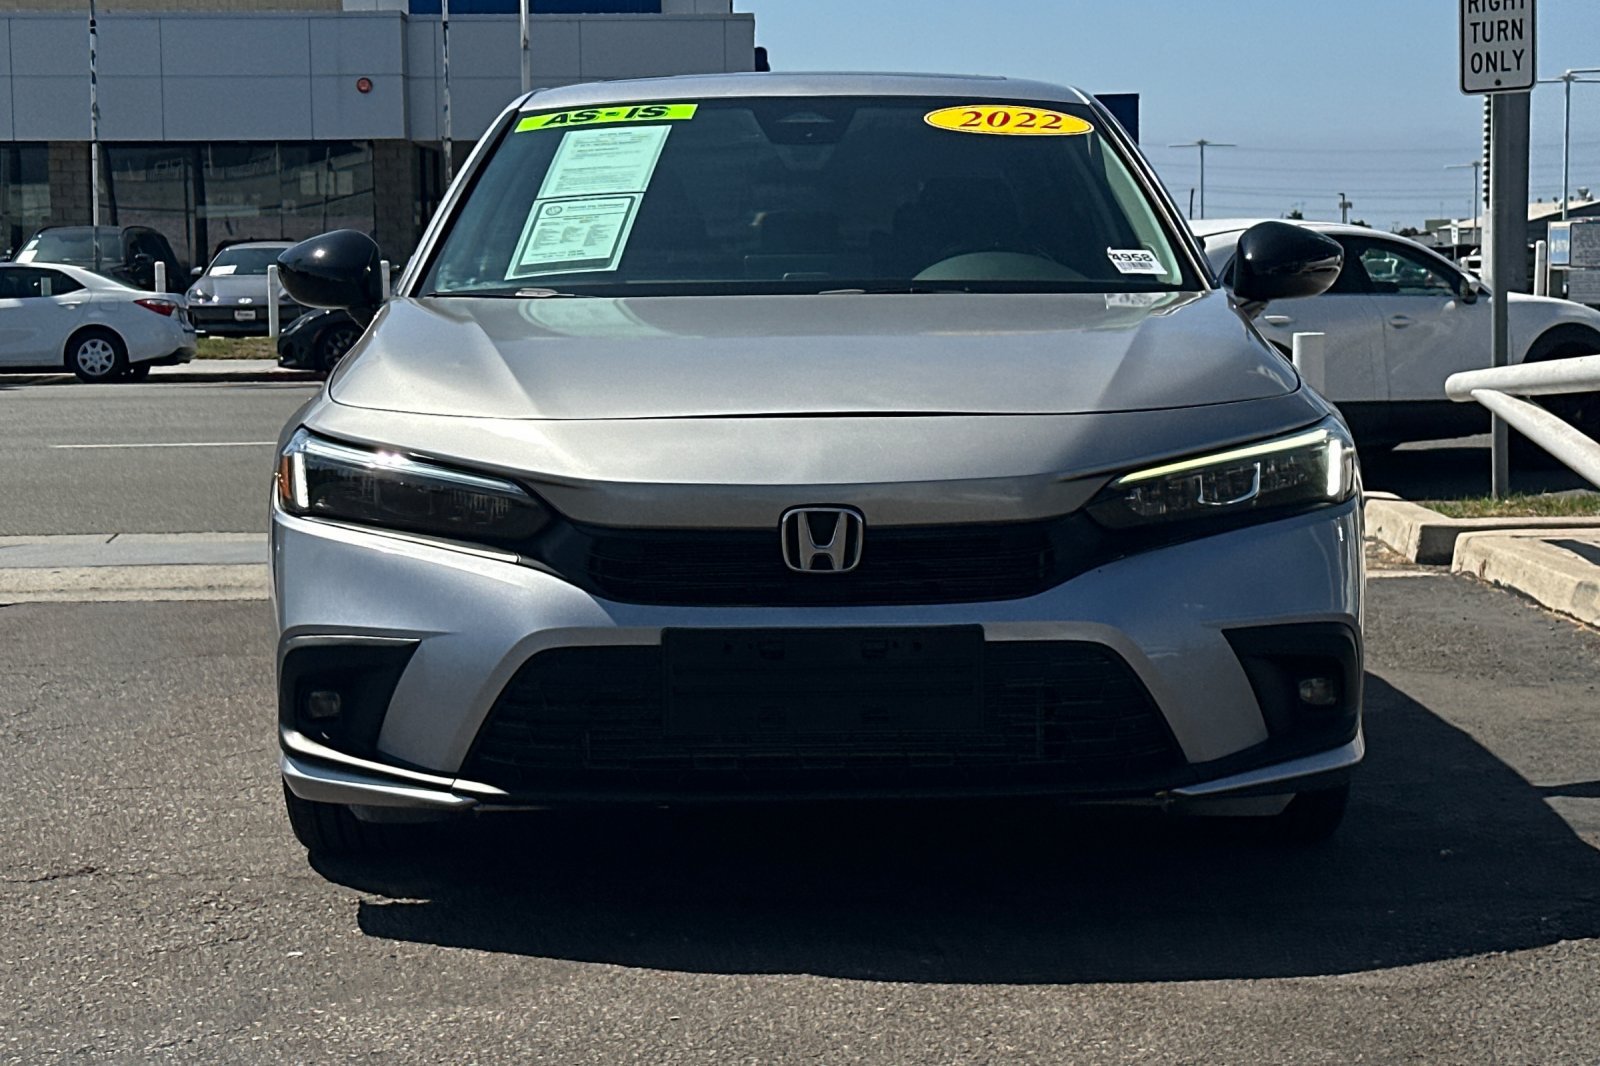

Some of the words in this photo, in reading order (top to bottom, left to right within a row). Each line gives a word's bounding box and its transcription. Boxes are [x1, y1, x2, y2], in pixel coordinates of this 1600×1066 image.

[1470, 18, 1523, 43] TURN
[1471, 48, 1524, 74] ONLY
[541, 106, 670, 126] AS-IS
[959, 111, 1062, 130] 2022
[1109, 253, 1153, 262] 4958
